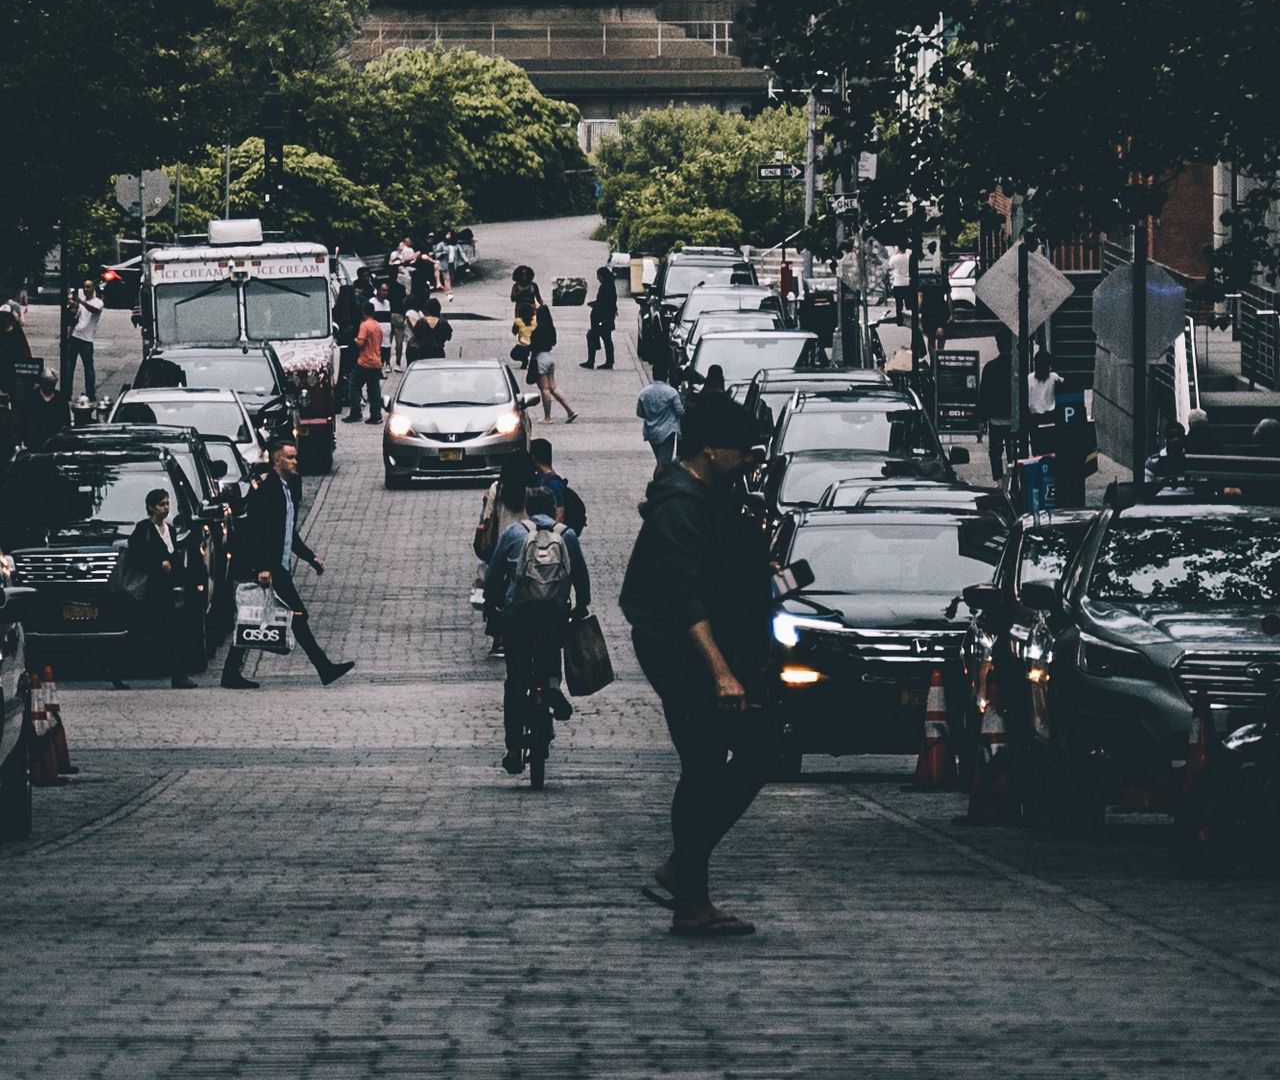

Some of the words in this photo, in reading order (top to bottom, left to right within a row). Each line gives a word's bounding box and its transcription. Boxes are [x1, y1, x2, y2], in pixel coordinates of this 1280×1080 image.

[836, 199, 855, 209] ONE
[161, 269, 180, 279] ICE
[182, 268, 224, 278] CREAM
[257, 265, 276, 275] ICE
[278, 264, 320, 274] CREAM
[1064, 406, 1075, 424] P
[242, 629, 280, 641] asos
